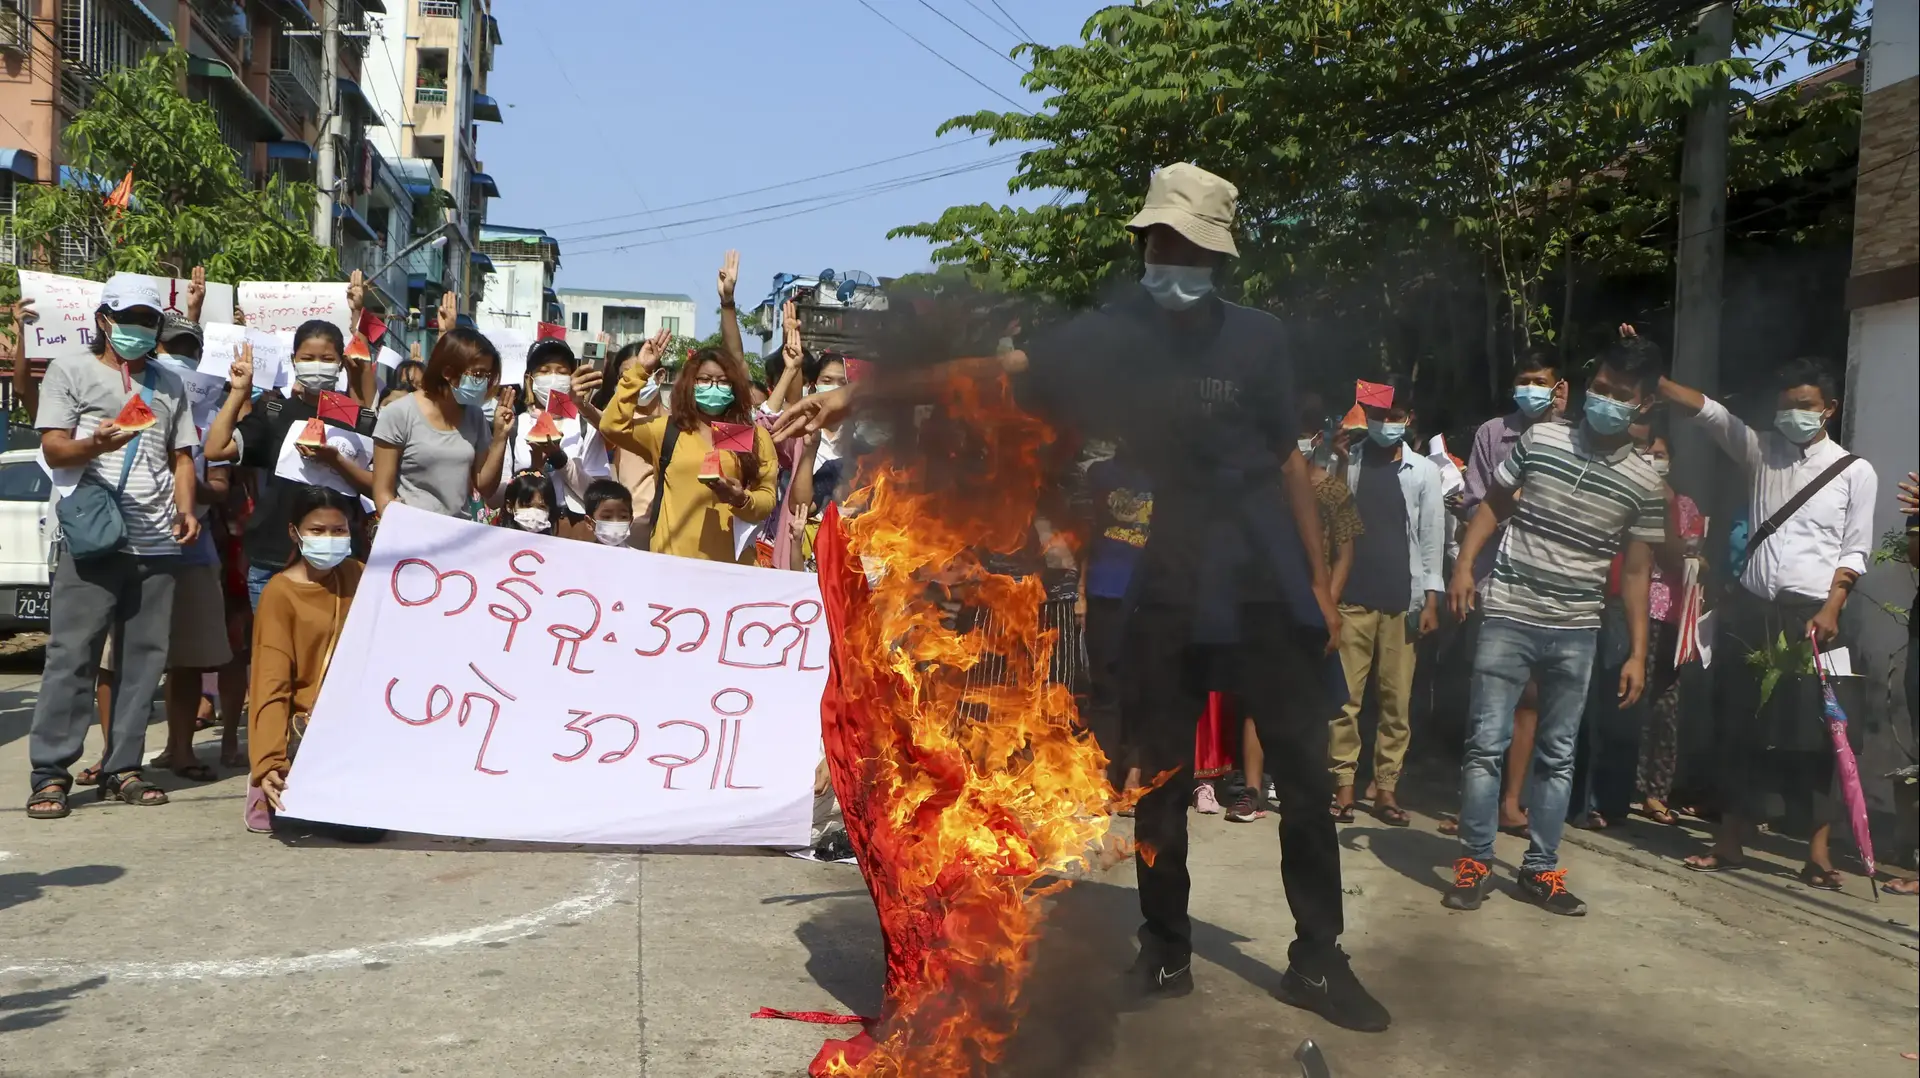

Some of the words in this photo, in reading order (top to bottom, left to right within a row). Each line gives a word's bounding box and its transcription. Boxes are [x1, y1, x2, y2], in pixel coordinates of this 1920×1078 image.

[63, 313, 86, 321] And
[36, 327, 67, 346] Fuck
[37, 591, 51, 599] YG
[19, 599, 49, 614] 7Q-4
